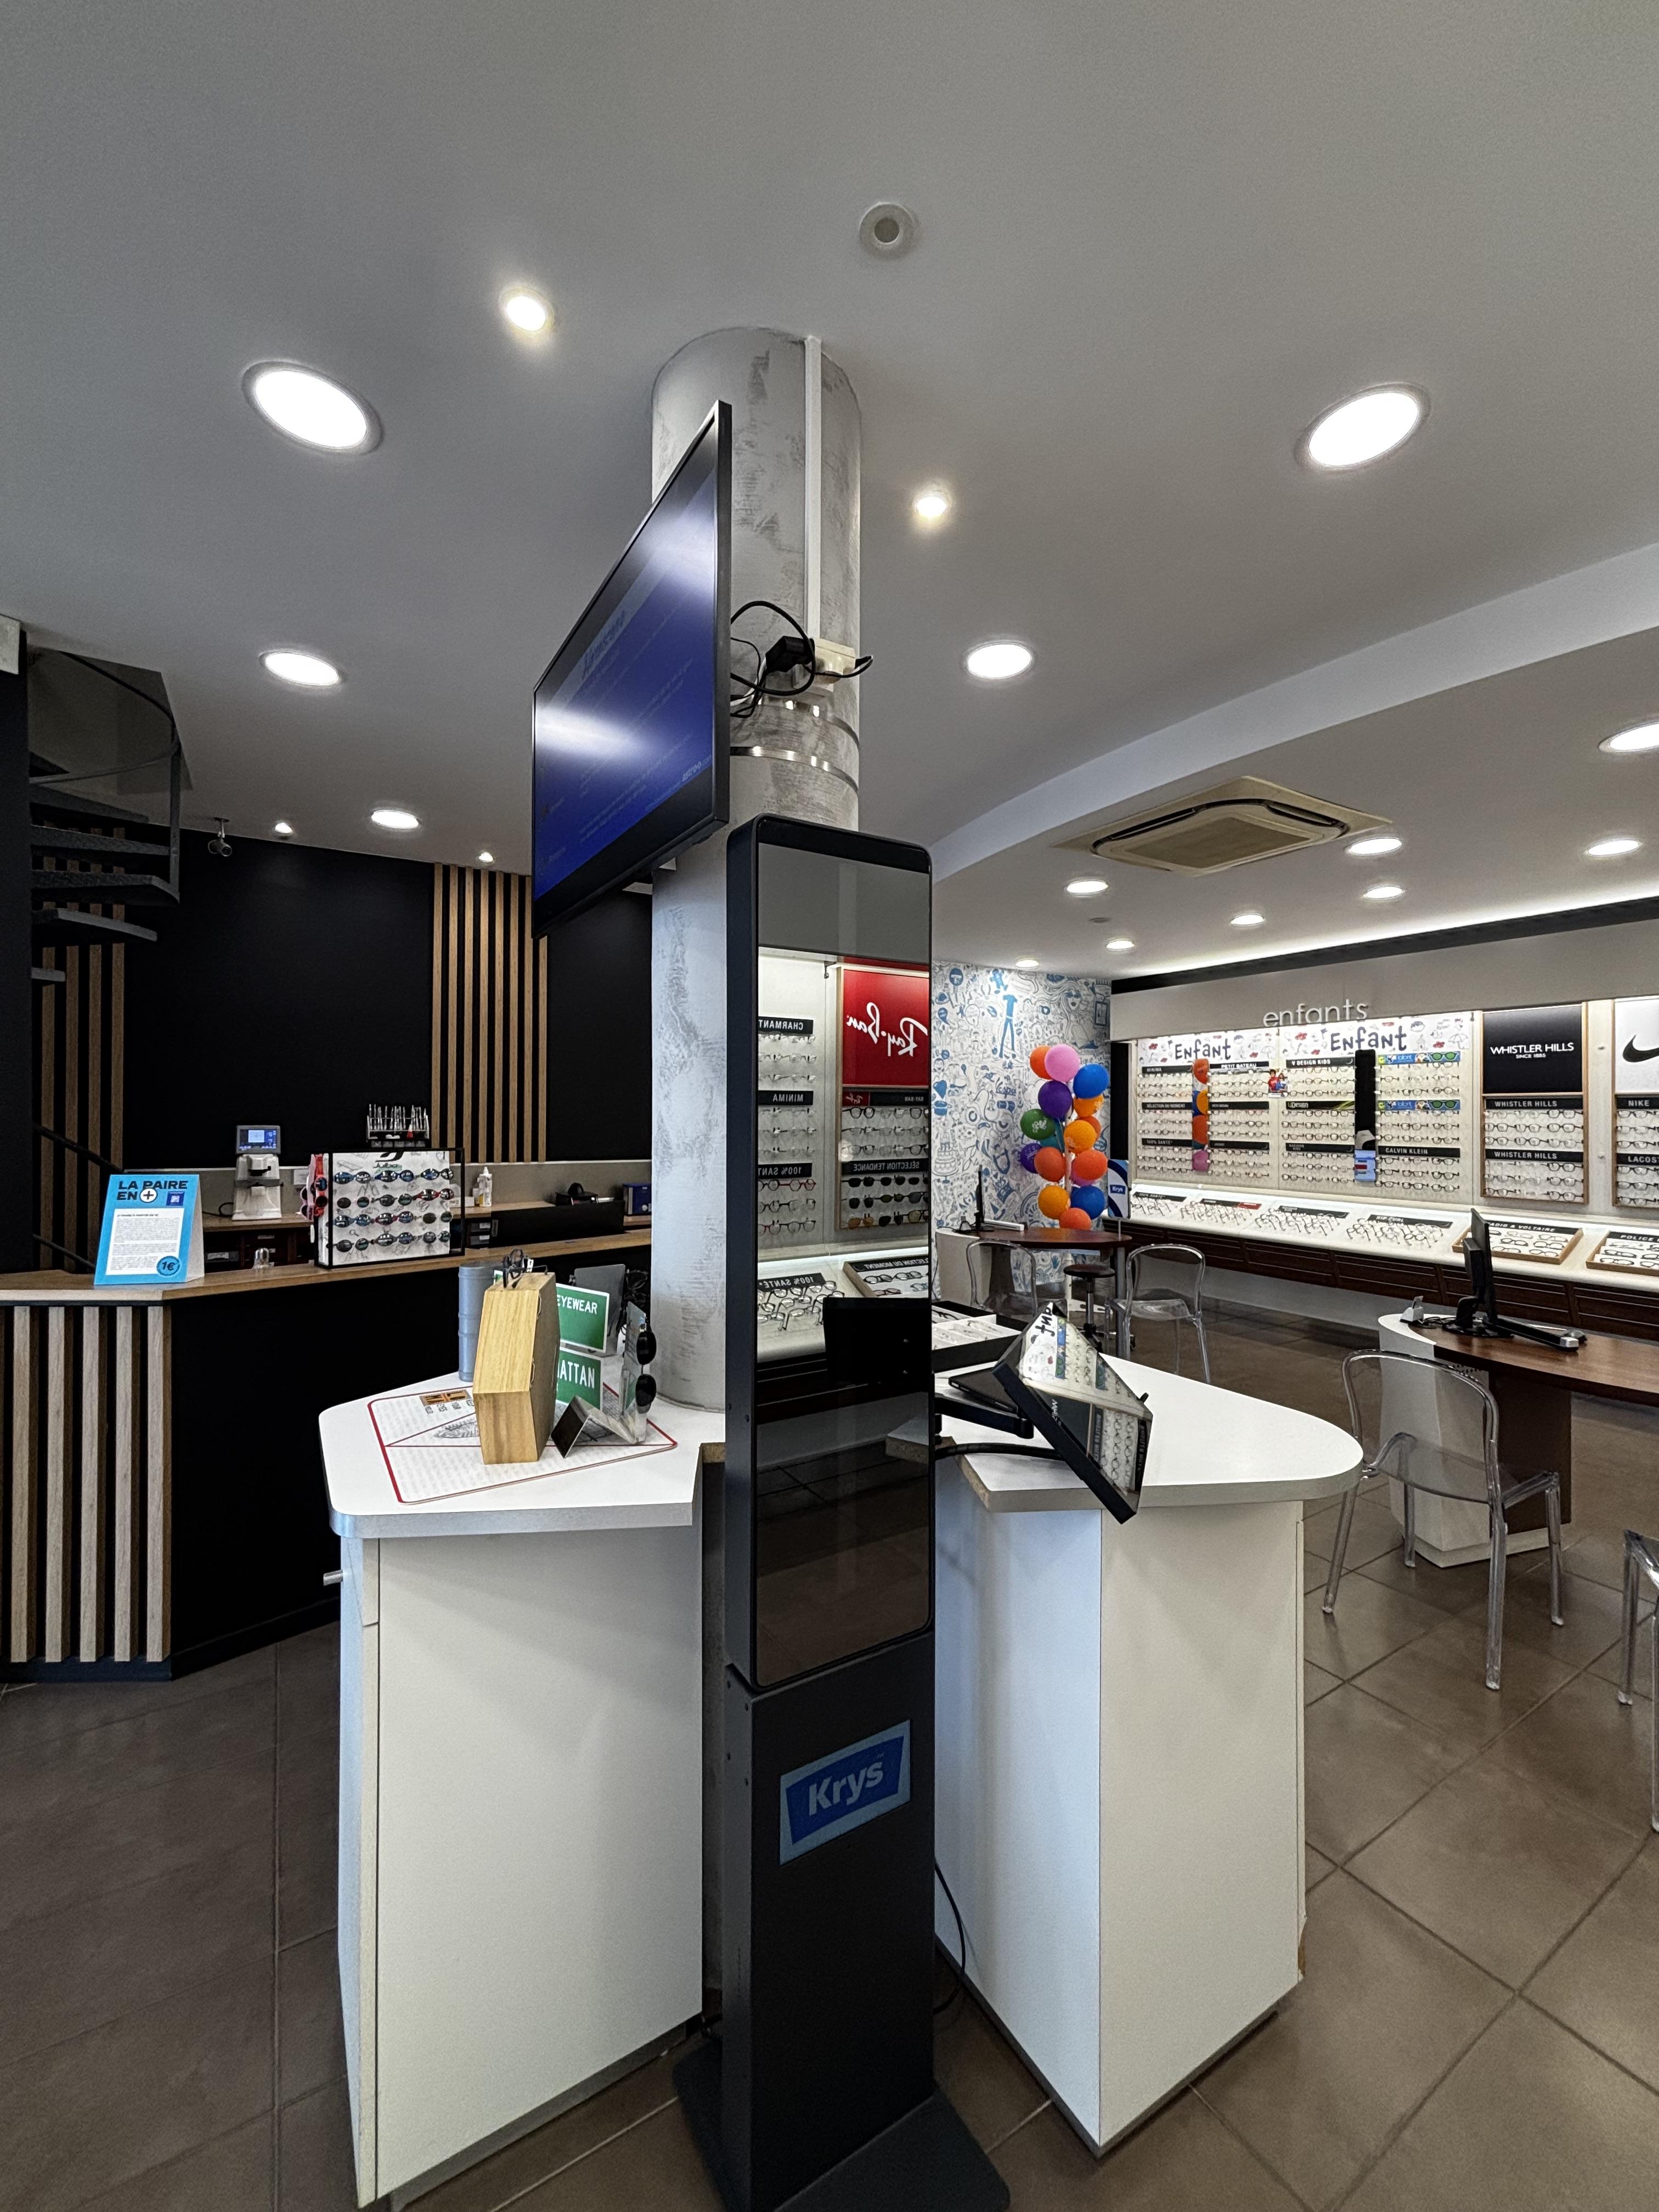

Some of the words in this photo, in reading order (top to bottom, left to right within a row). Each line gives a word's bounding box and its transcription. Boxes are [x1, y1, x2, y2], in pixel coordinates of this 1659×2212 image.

[1263, 998, 1369, 1027] enfants
[1490, 1044, 1543, 1055] WHISTLER
[1545, 1042, 1574, 1052] HILLS
[995, 1077, 1016, 1099] Vespa
[119, 1181, 138, 1189] LA
[143, 1180, 188, 1190] PAIRE
[117, 1191, 138, 1200] EN
[162, 1261, 176, 1271] 1€
[557, 1294, 598, 1314] EYEWEAR
[809, 1762, 884, 1816] Krys
